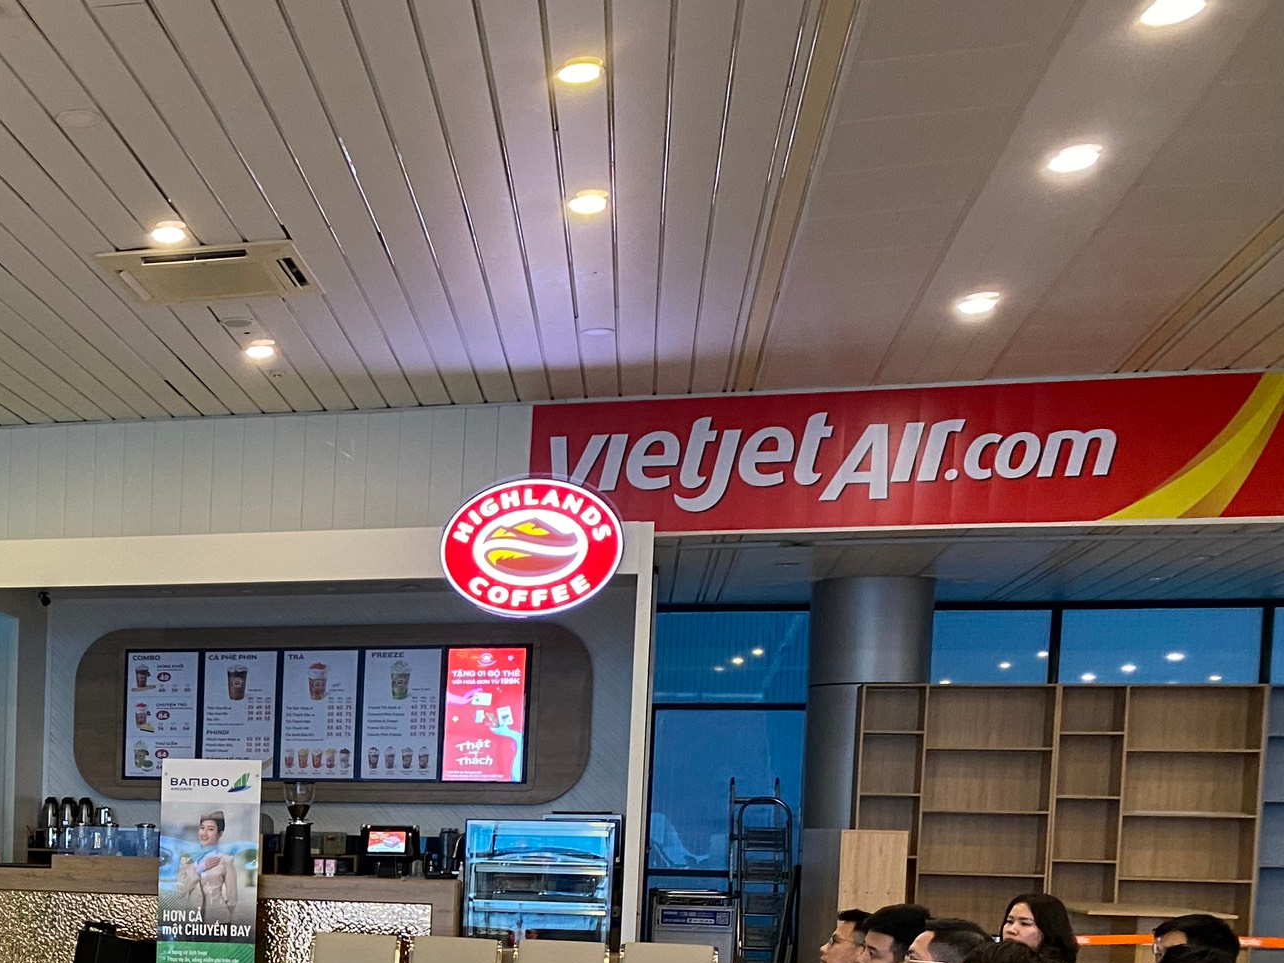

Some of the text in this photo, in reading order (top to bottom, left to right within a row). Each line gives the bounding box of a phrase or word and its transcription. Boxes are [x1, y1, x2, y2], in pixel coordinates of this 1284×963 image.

[452, 488, 612, 544] HIGHLANDS
[468, 573, 593, 608] COFFEE
[456, 739, 491, 751] Thật
[170, 778, 229, 787] BAMBOO
[163, 910, 186, 922] HƠN
[162, 924, 183, 938] một
[230, 925, 251, 937] BAY
